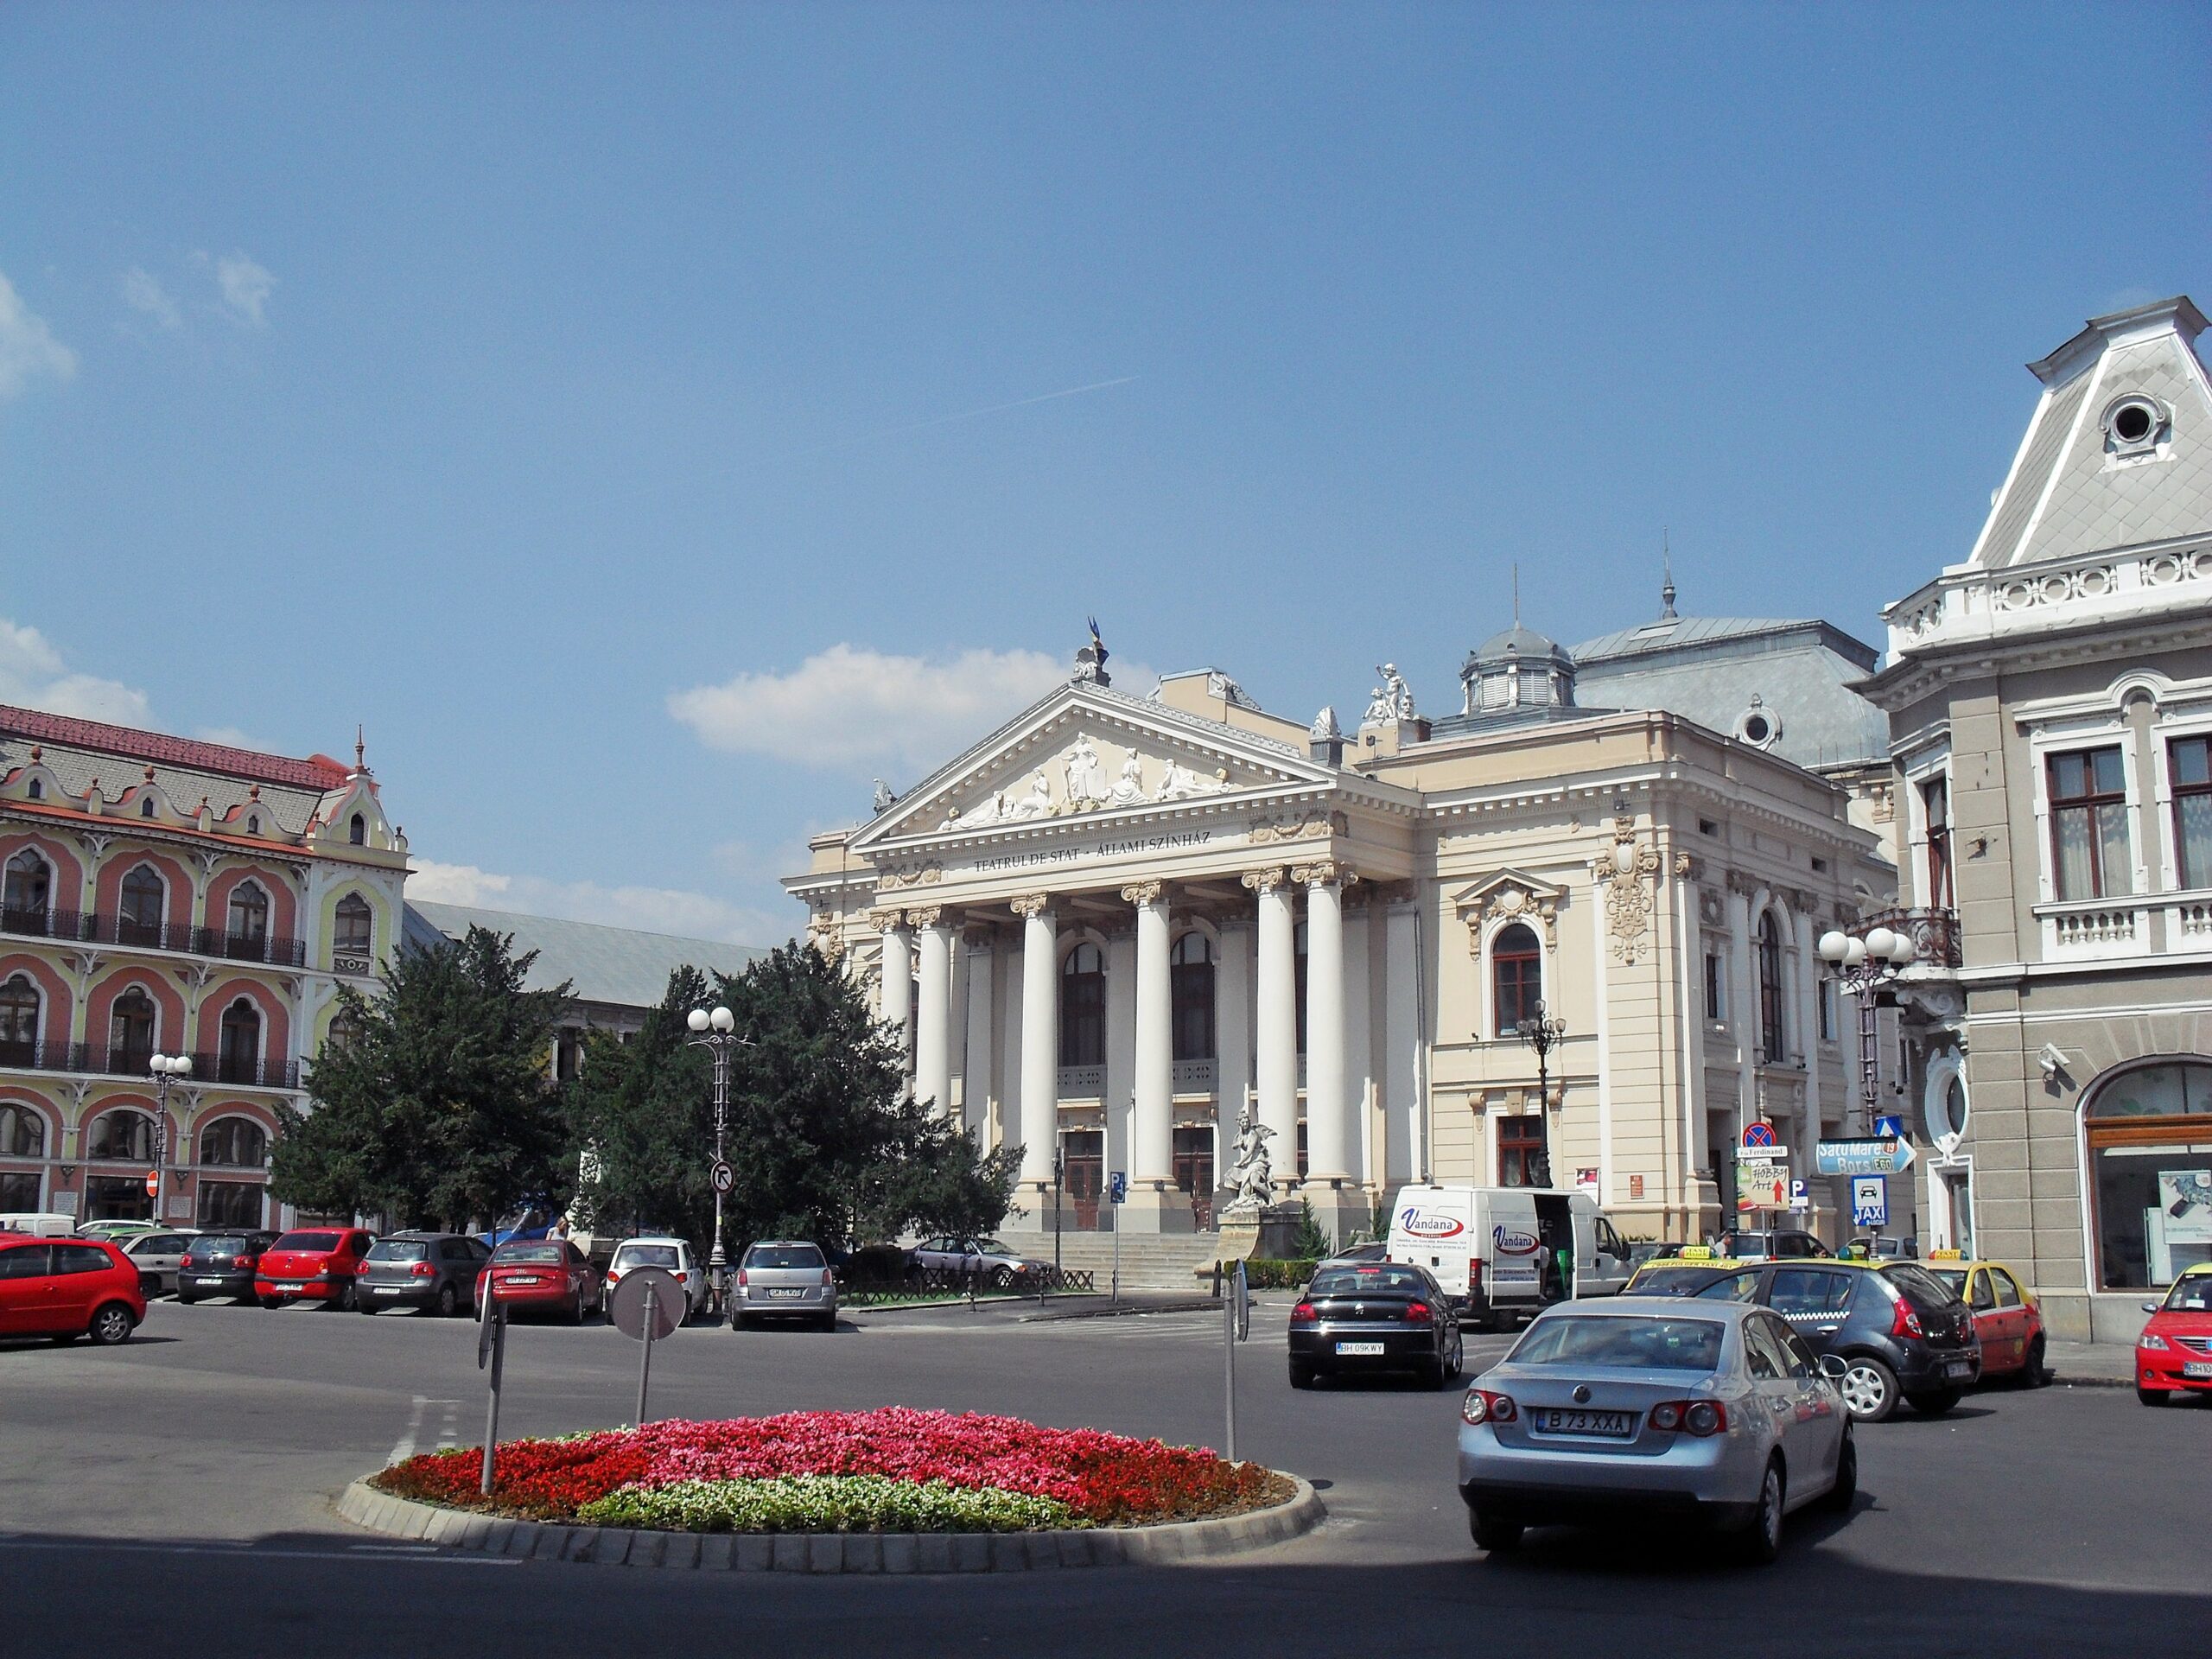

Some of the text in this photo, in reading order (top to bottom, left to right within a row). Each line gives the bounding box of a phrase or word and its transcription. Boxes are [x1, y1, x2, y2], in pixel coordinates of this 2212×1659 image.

[975, 830, 1211, 872] TEATRUL DE STAT ÁLLAMI SZÍNHÁZ
[1401, 1208, 1452, 1230] Vandana
[1856, 1206, 1885, 1220] TAXI
[1492, 1224, 1533, 1248] Vandana
[1340, 1344, 1353, 1352] BH
[1549, 1412, 1624, 1431] B 73 XXA
